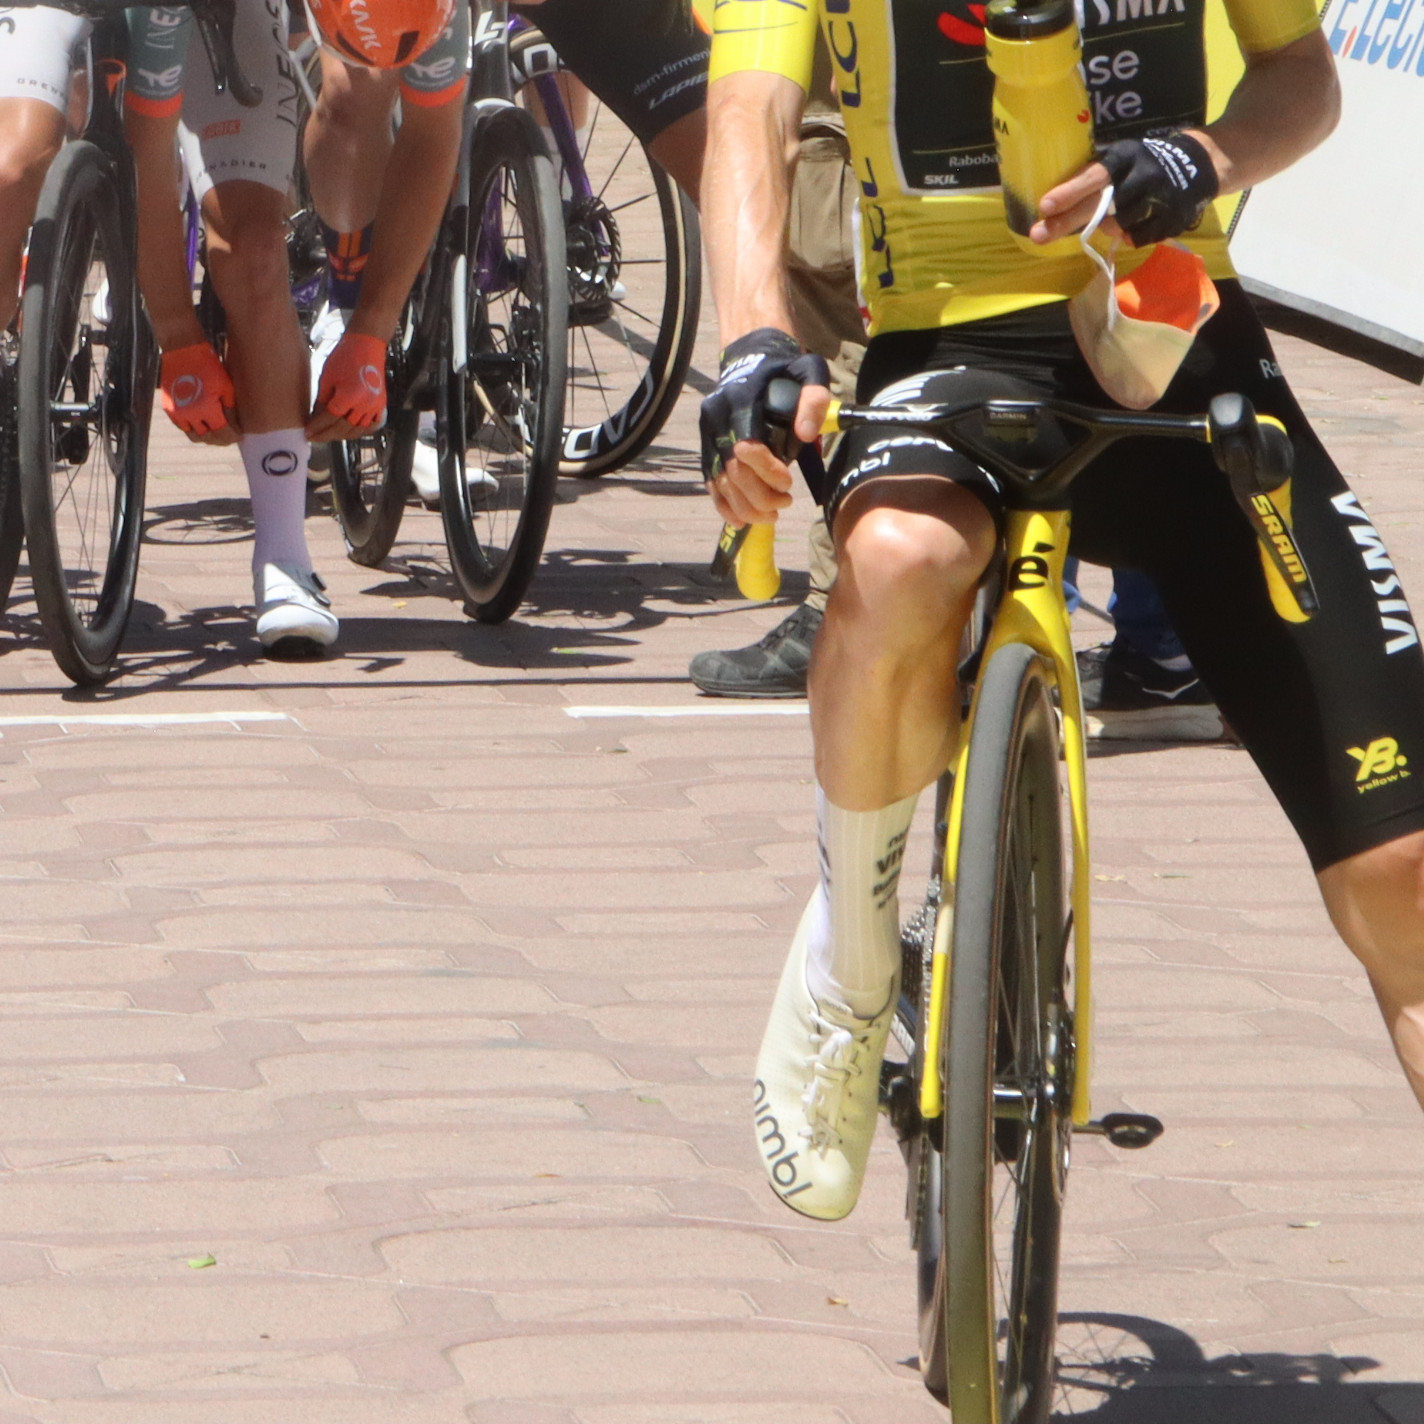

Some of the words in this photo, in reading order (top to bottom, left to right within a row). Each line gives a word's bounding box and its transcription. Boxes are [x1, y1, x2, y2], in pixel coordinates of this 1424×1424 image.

[924, 173, 959, 186] SKIL
[1250, 492, 1308, 584] SRAM
[1330, 490, 1421, 656] VISMA
[1357, 775, 1400, 794] yellow
[752, 1077, 814, 1204] nimbl
